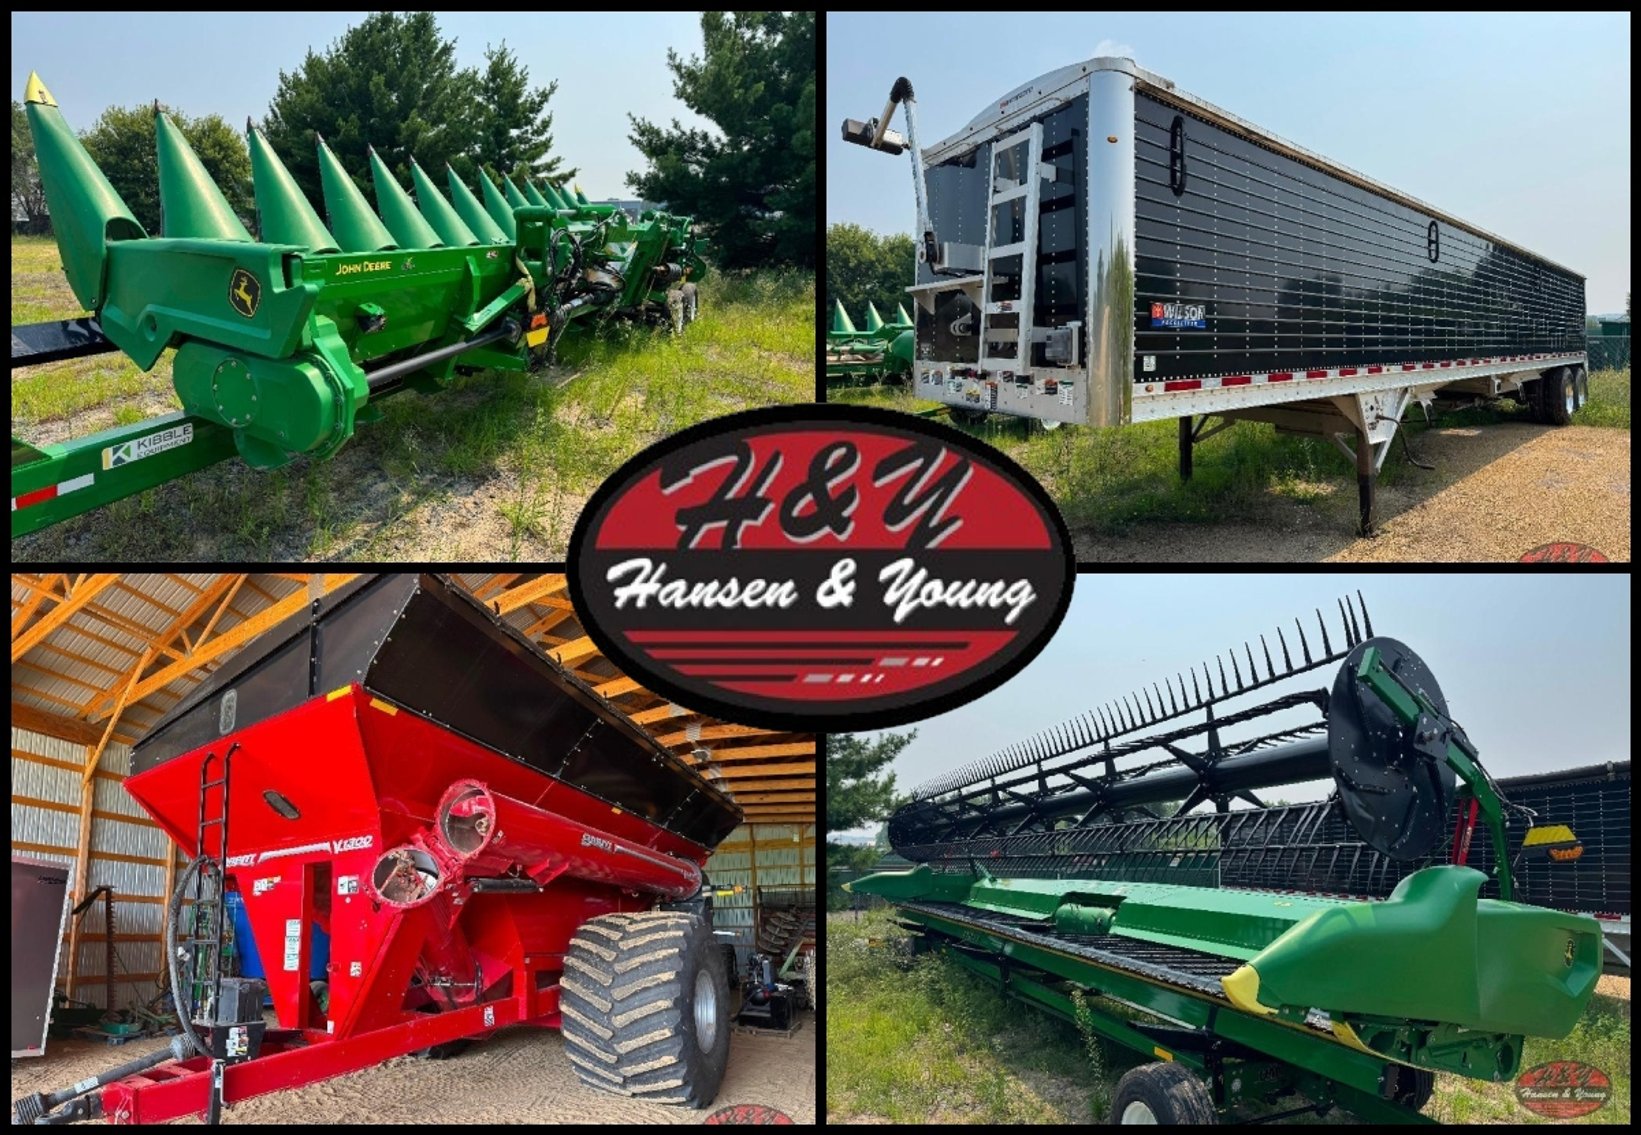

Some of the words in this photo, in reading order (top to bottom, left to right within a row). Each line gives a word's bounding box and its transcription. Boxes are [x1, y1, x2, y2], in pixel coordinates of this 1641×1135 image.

[335, 263, 362, 275] JOHN
[363, 261, 392, 272] DEERE
[1163, 303, 1206, 320] WILSON
[137, 425, 192, 450] KIBBLE
[136, 437, 191, 459] EQUIPMENT
